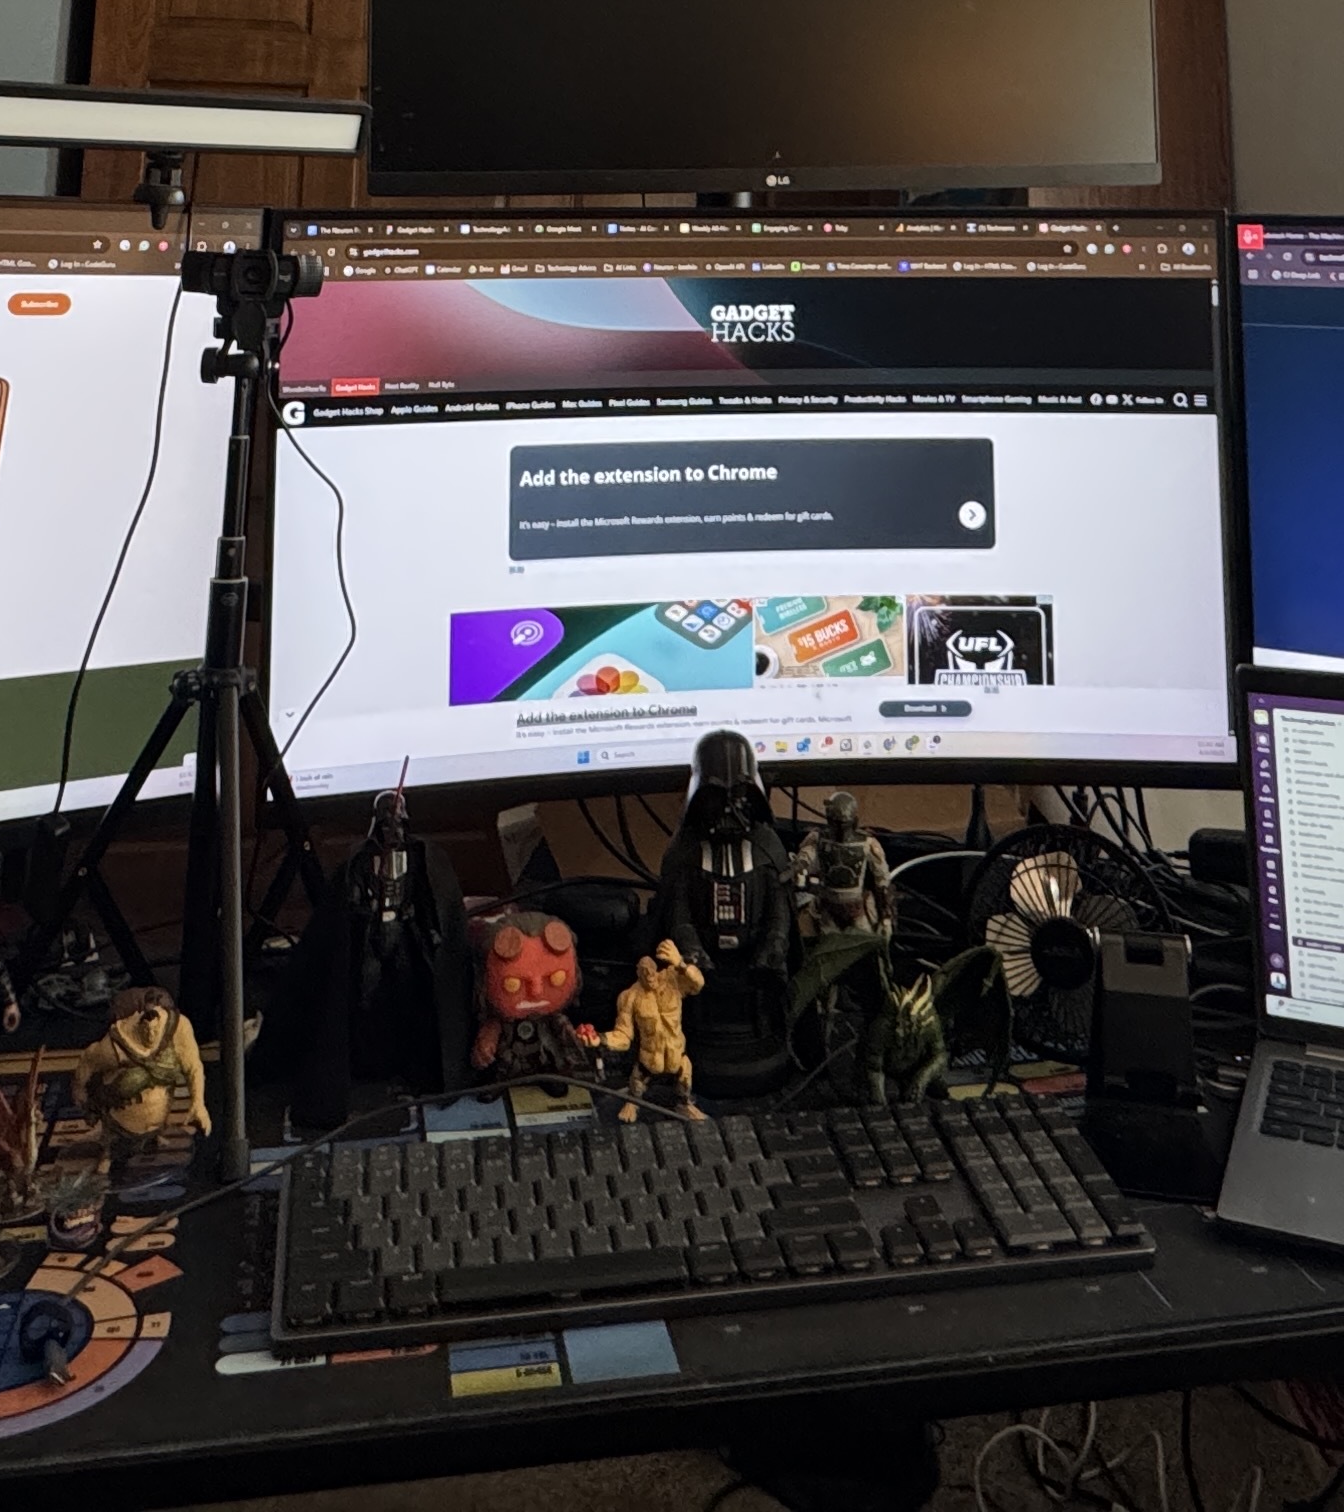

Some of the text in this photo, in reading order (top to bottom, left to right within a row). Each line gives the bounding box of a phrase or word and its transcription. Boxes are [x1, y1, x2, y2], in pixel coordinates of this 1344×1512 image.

[778, 176, 790, 185] LG
[711, 303, 796, 323] GADGET
[711, 322, 796, 344] HACKS
[282, 401, 306, 426] G
[313, 406, 384, 419] Gadget Hacks Shop
[390, 405, 412, 415] Apple
[445, 403, 474, 413] Android
[519, 464, 778, 487] Add the extension to Chrome
[532, 511, 810, 531] easy the Microsoft points redeem for gift
[797, 619, 850, 650] $15 BUCKS
[958, 636, 1003, 653] UFL
[939, 673, 1025, 686] CHAMPIONSHIP
[516, 702, 697, 725] Add the extension to Chrome
